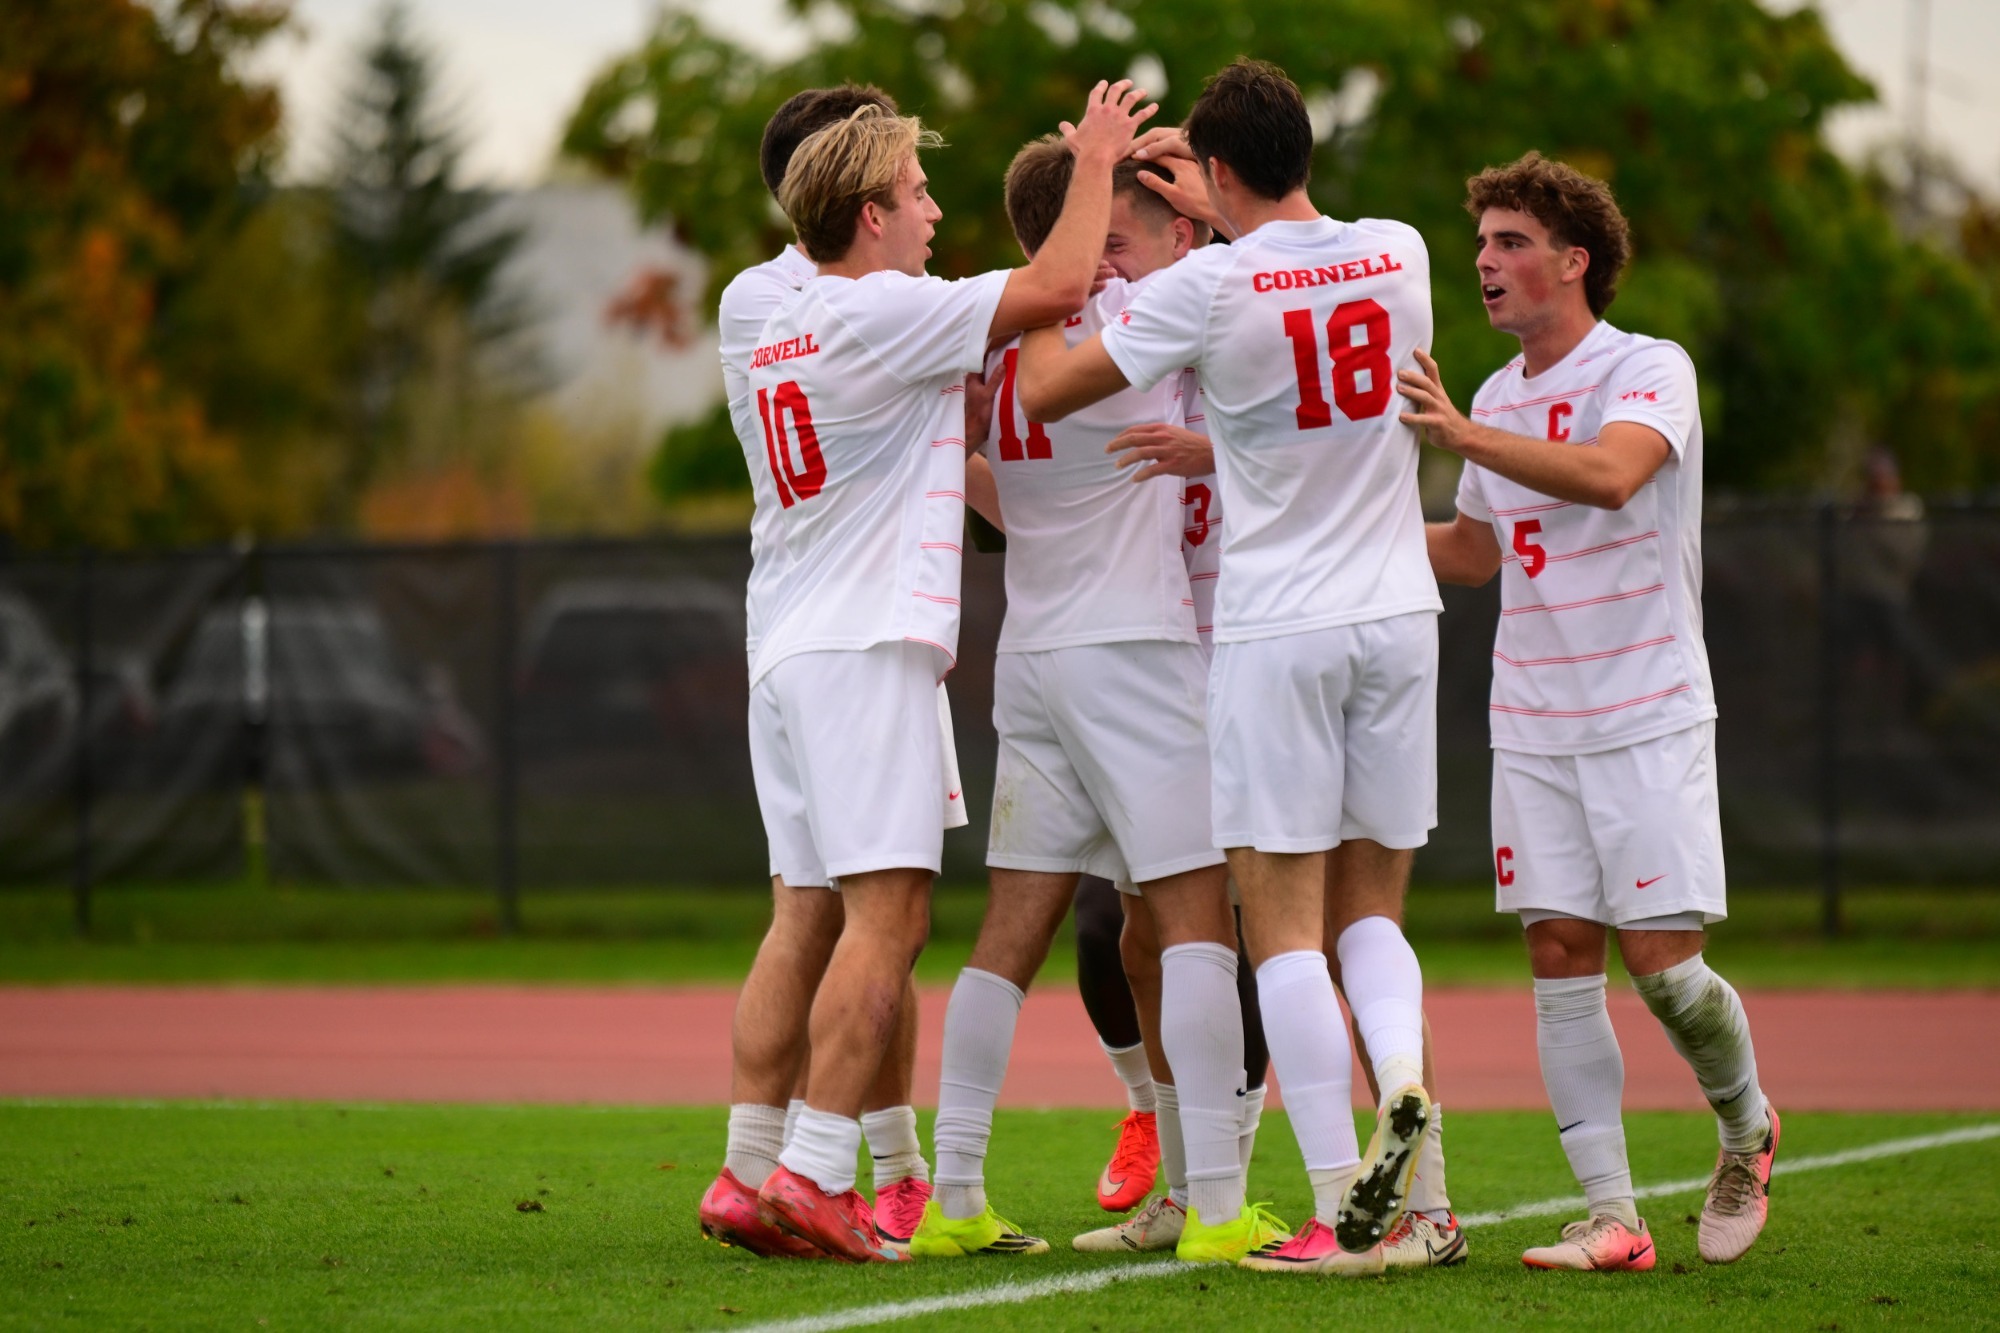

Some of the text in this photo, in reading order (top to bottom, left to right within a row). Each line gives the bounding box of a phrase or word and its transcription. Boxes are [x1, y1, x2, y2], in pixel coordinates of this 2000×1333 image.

[1253, 253, 1402, 292] CORNELL
[1283, 298, 1392, 430] 18
[757, 380, 827, 510] 10
[1548, 401, 1573, 442] C
[1512, 519, 1546, 579] 5
[1496, 846, 1515, 887] C
